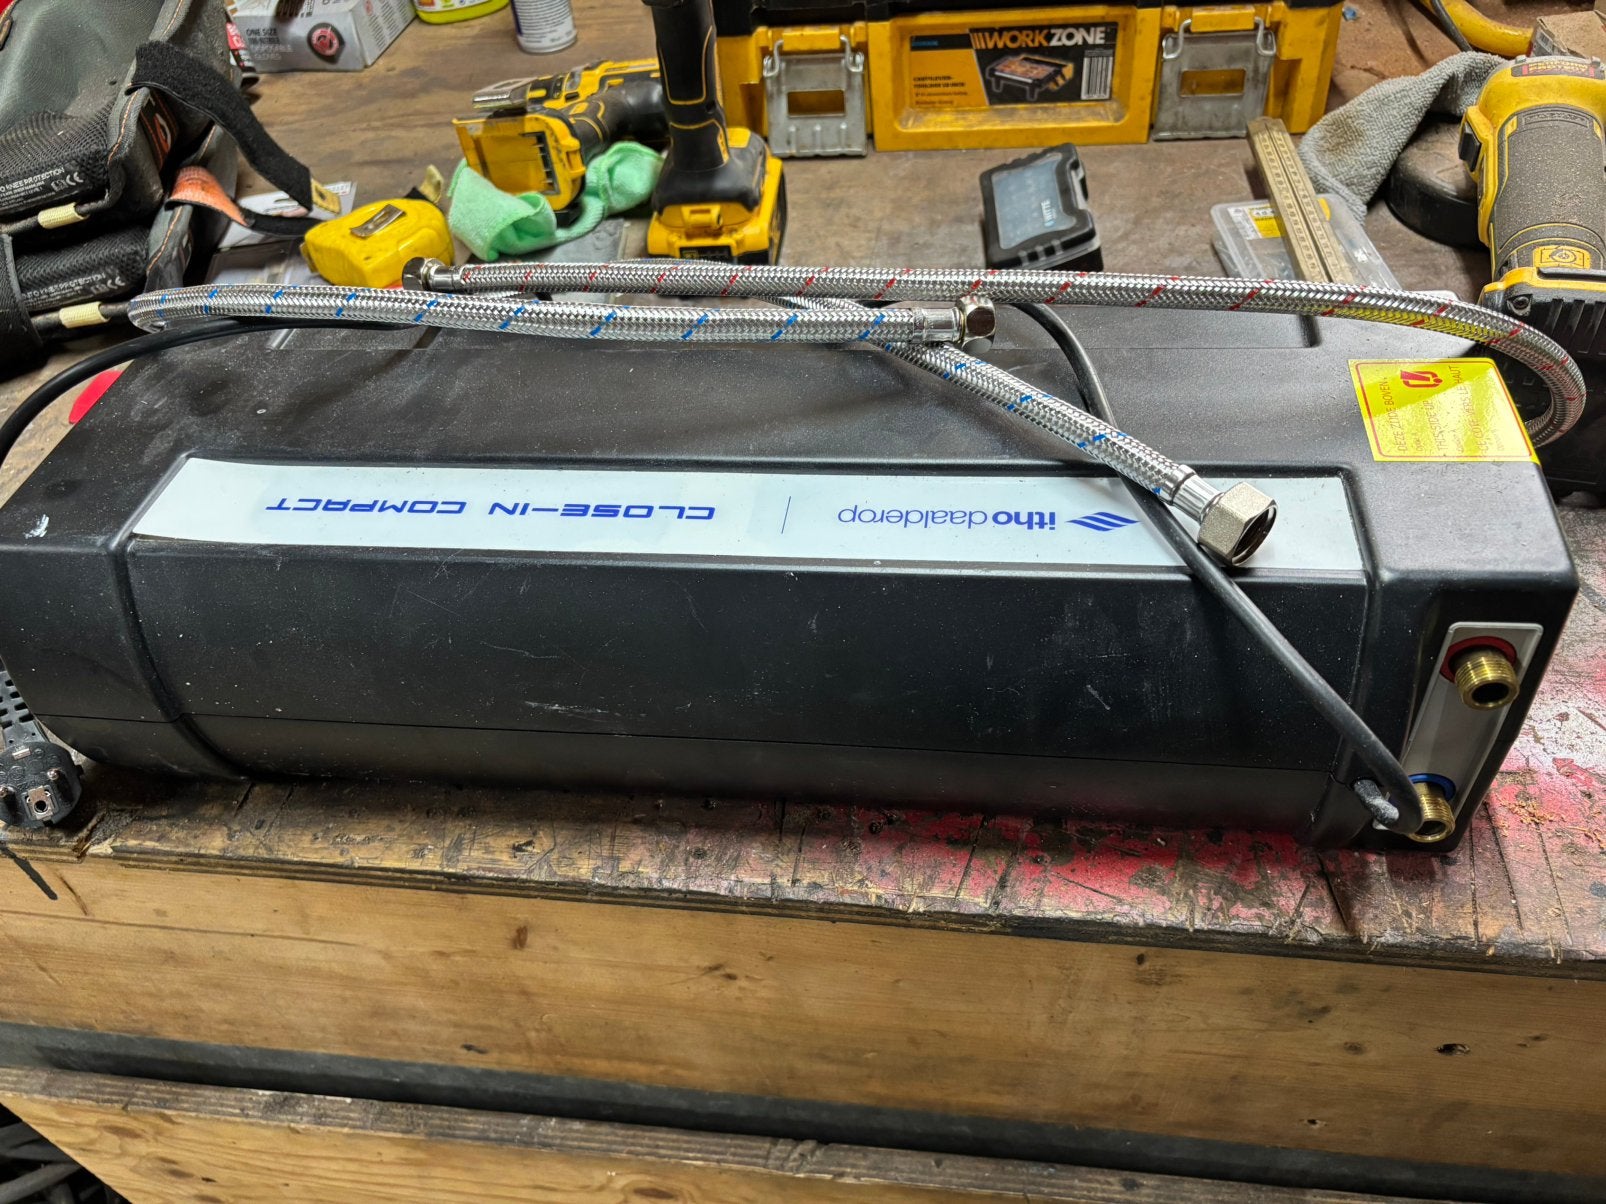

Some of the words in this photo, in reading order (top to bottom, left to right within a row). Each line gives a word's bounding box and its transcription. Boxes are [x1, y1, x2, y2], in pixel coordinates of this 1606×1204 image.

[24, 166, 66, 186] PROTECTION
[1423, 400, 1434, 410] UP
[1428, 411, 1441, 431] SIDE
[1393, 431, 1408, 453] DEZE
[1433, 432, 1448, 451] THIS
[264, 497, 468, 515] COMPACT
[488, 501, 717, 521] CLOSE-IN
